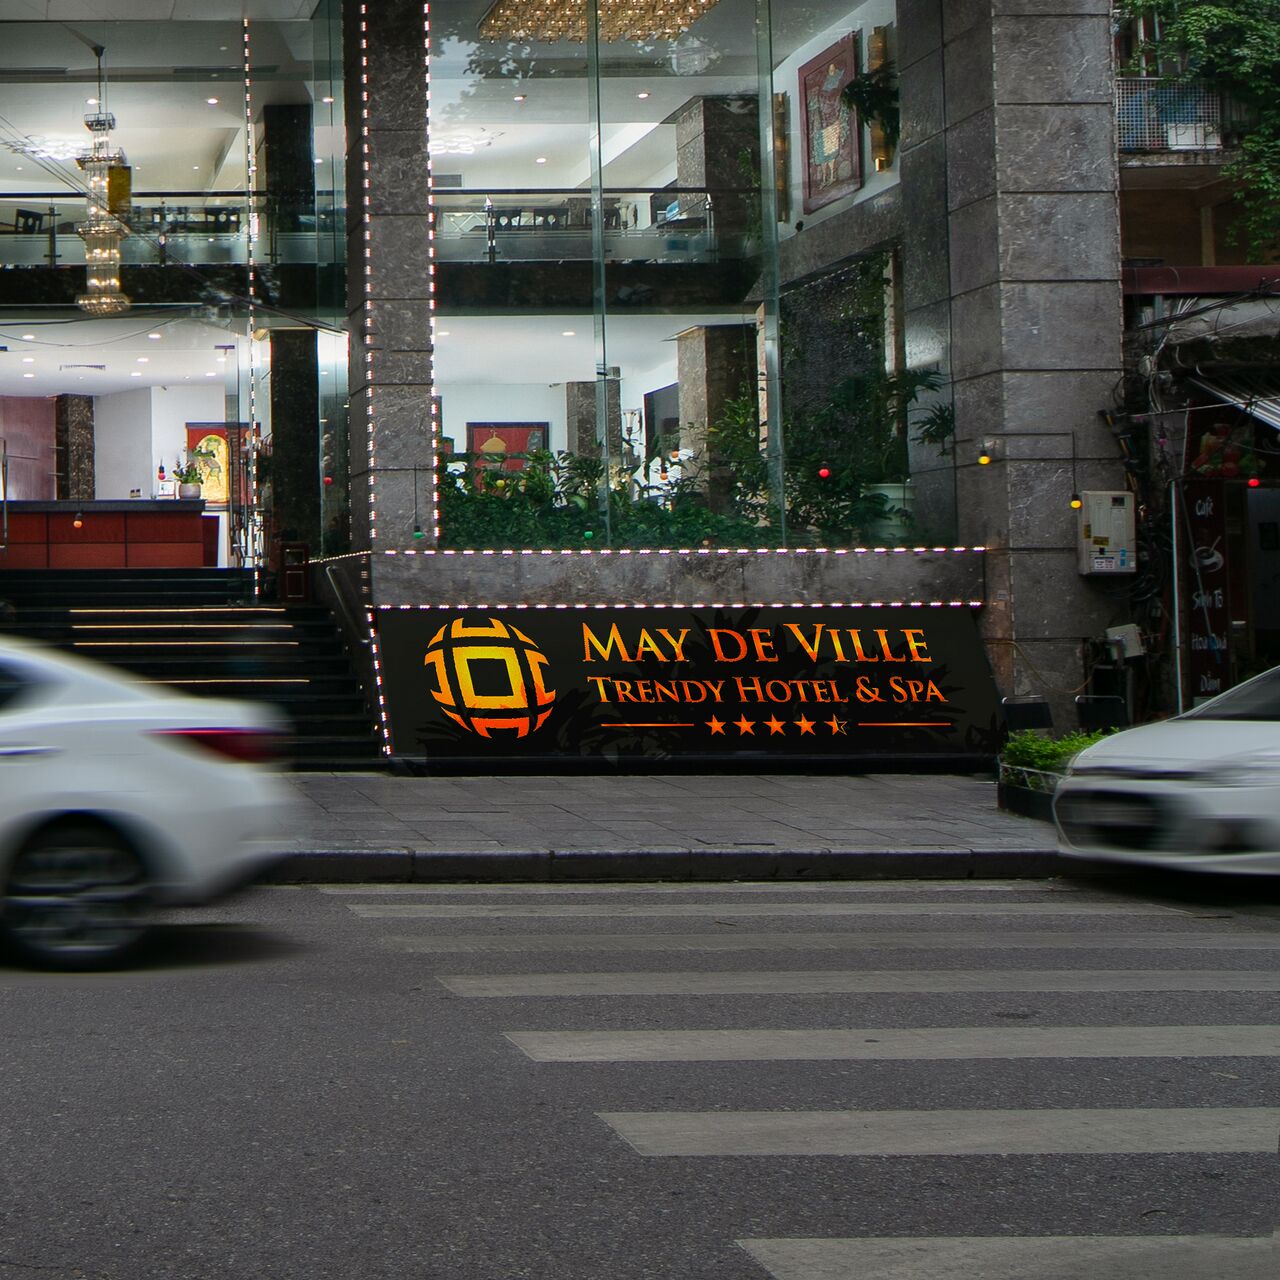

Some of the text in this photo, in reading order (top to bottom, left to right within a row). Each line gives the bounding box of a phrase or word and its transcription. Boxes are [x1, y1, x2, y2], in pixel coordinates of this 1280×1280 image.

[582, 622, 932, 663] MAY DE VILLE
[586, 675, 949, 704] TRENDY HOTEL & SPA
